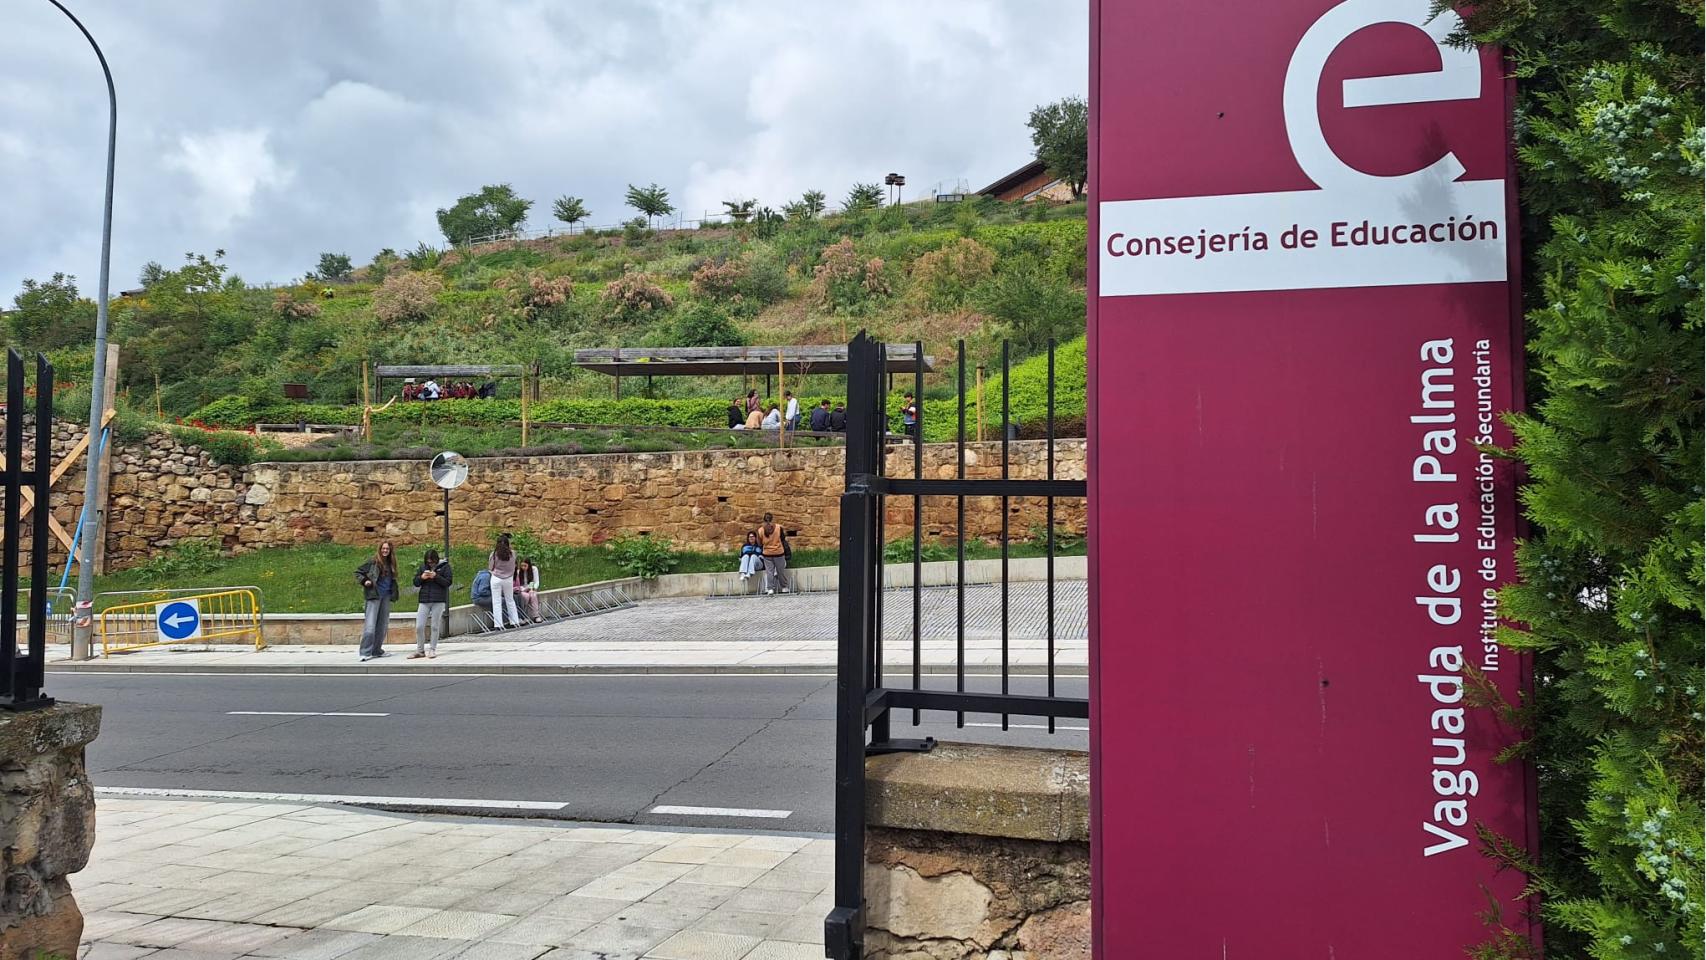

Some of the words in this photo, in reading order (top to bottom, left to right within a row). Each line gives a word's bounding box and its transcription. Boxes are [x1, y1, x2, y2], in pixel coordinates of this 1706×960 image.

[1107, 226, 1269, 259] Consejería
[1280, 224, 1318, 249] de
[1331, 215, 1498, 247] Educación
[1410, 338, 1457, 482] Palma
[1472, 339, 1493, 446] Secundaria
[1413, 503, 1460, 543] la
[1475, 453, 1496, 550] Educación
[1415, 564, 1462, 625] de
[1477, 557, 1497, 581] de
[1480, 588, 1499, 671] Instituto
[1417, 645, 1479, 857] Vaguada
